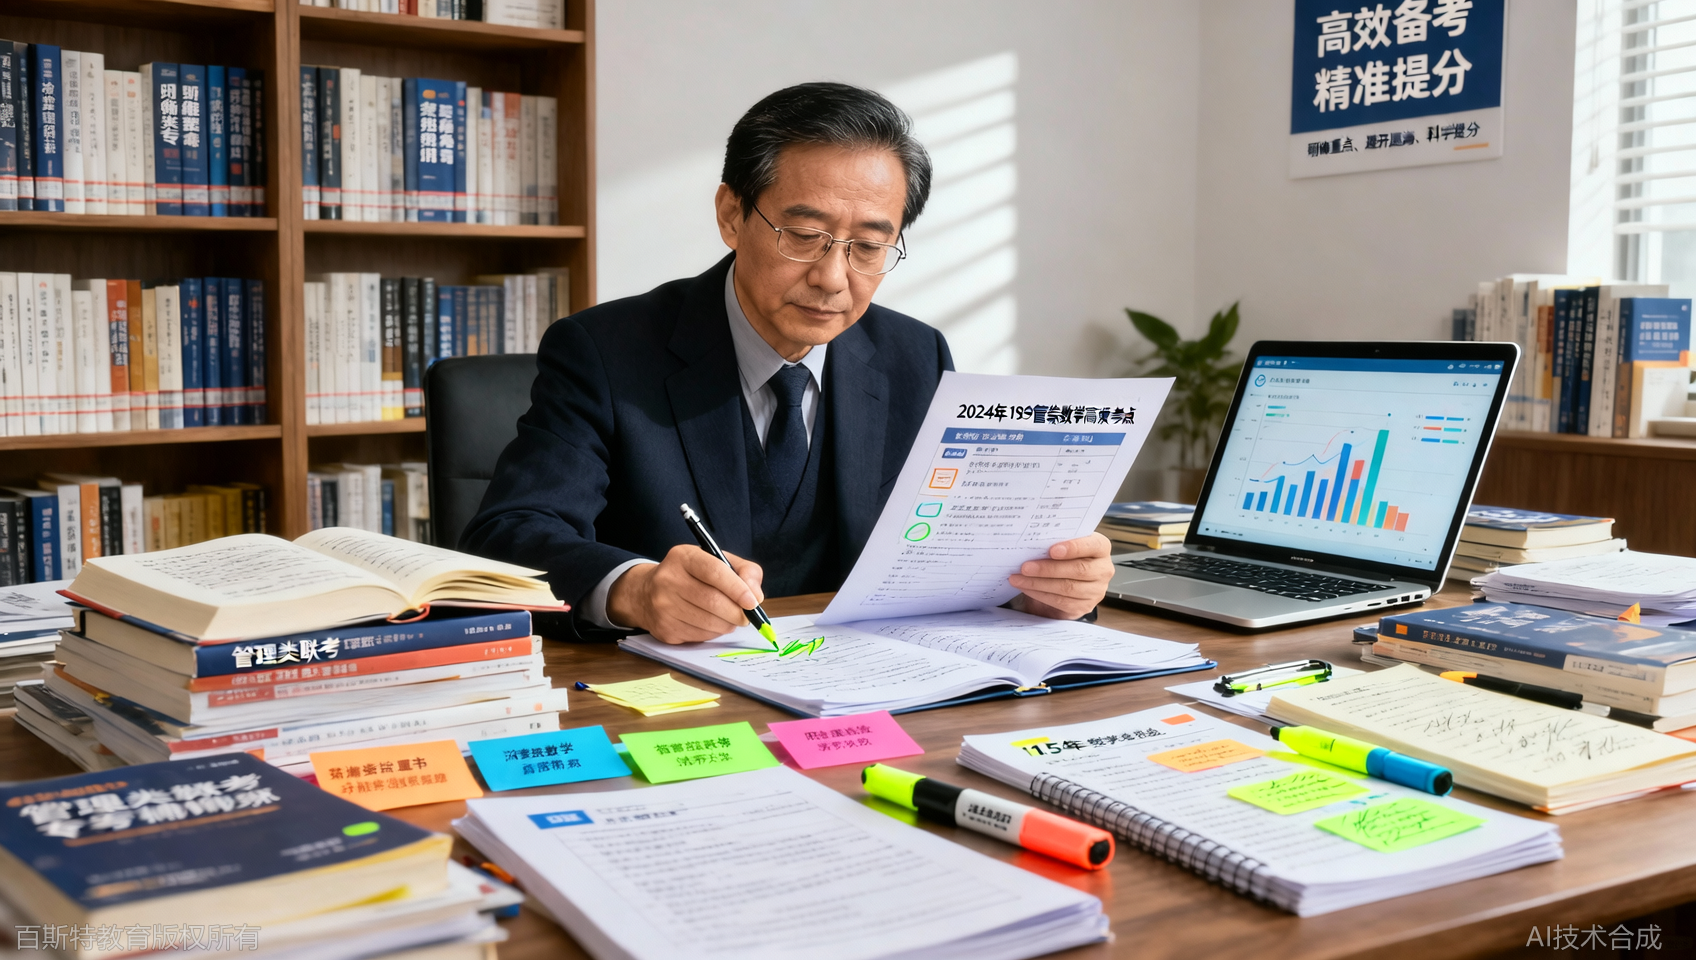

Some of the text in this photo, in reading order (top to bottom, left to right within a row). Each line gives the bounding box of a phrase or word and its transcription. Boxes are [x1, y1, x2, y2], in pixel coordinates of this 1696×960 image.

[1316, 0, 1474, 58] 高效备考
[1313, 48, 1473, 113] 精准提分
[231, 637, 341, 668] 管理类联考
